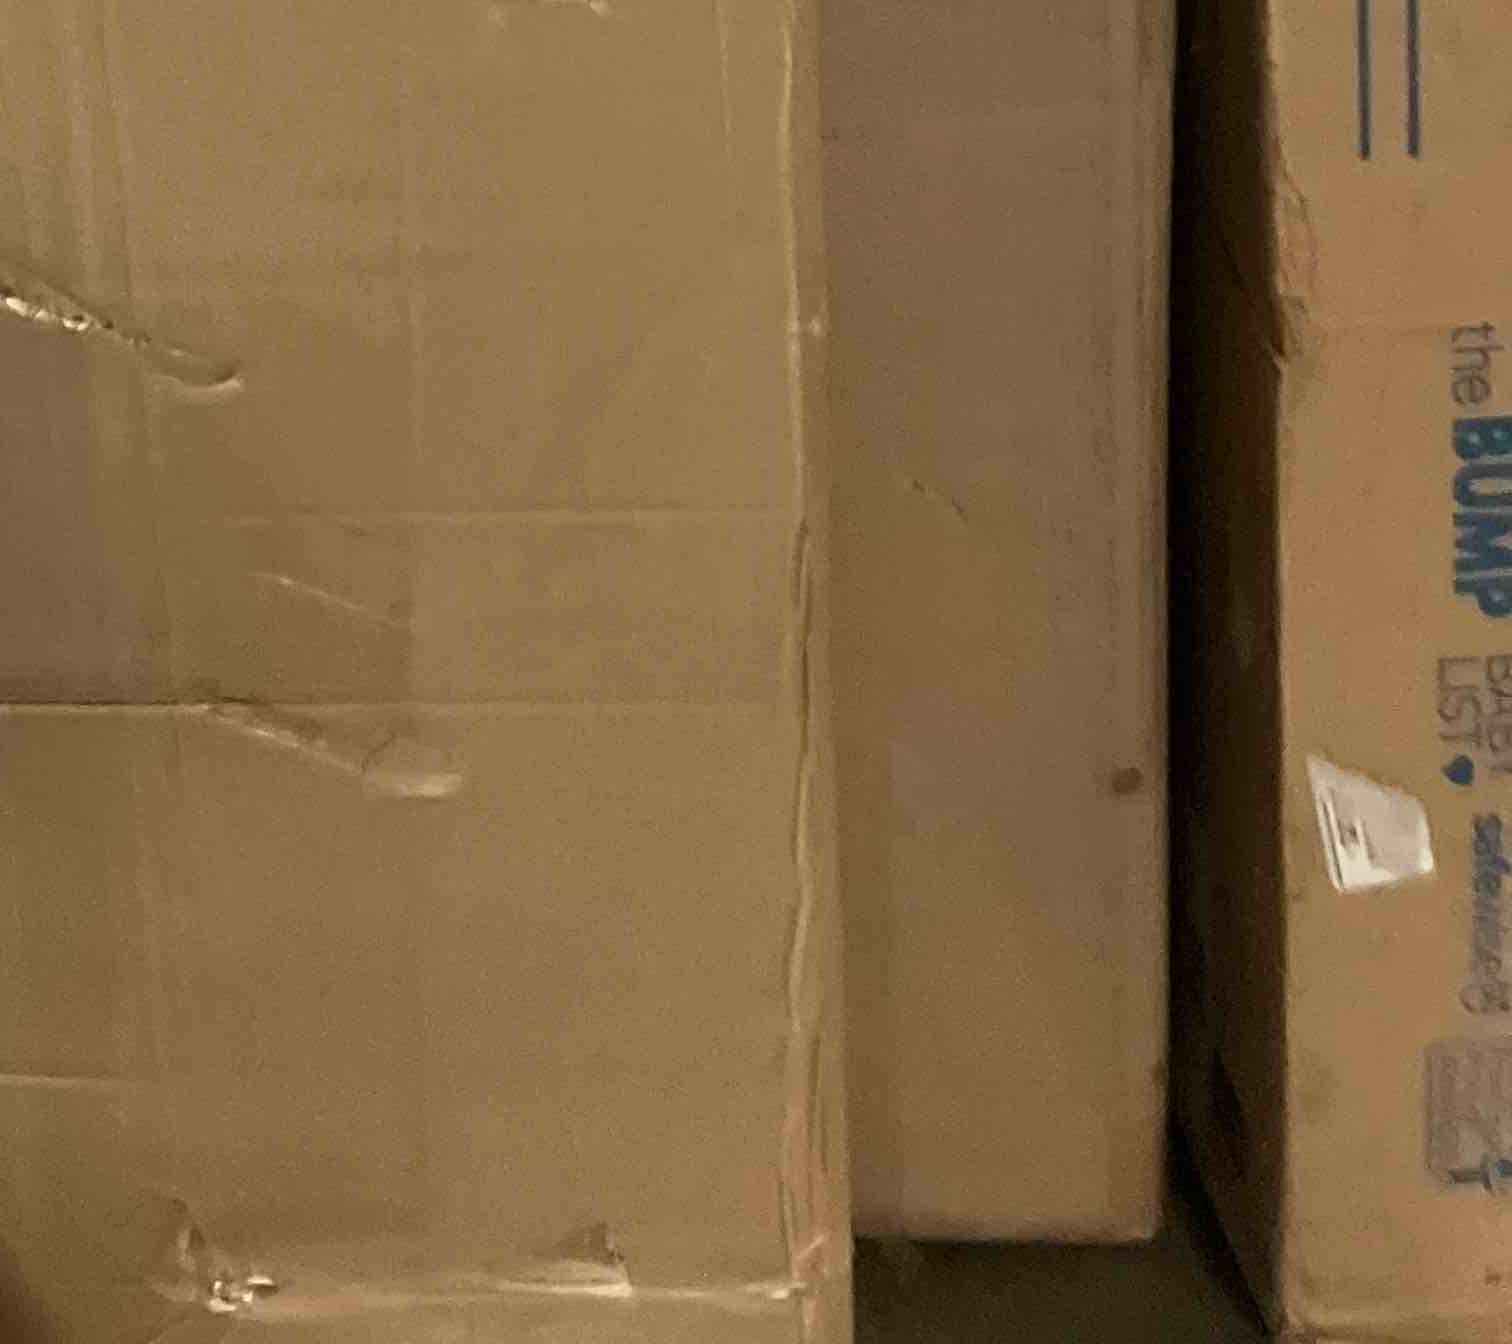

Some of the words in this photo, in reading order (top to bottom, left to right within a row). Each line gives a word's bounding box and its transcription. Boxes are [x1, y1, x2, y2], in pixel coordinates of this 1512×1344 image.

[1452, 322, 1503, 406] the
[1452, 418, 1512, 618] BUMP
[1439, 657, 1483, 749] LIST
